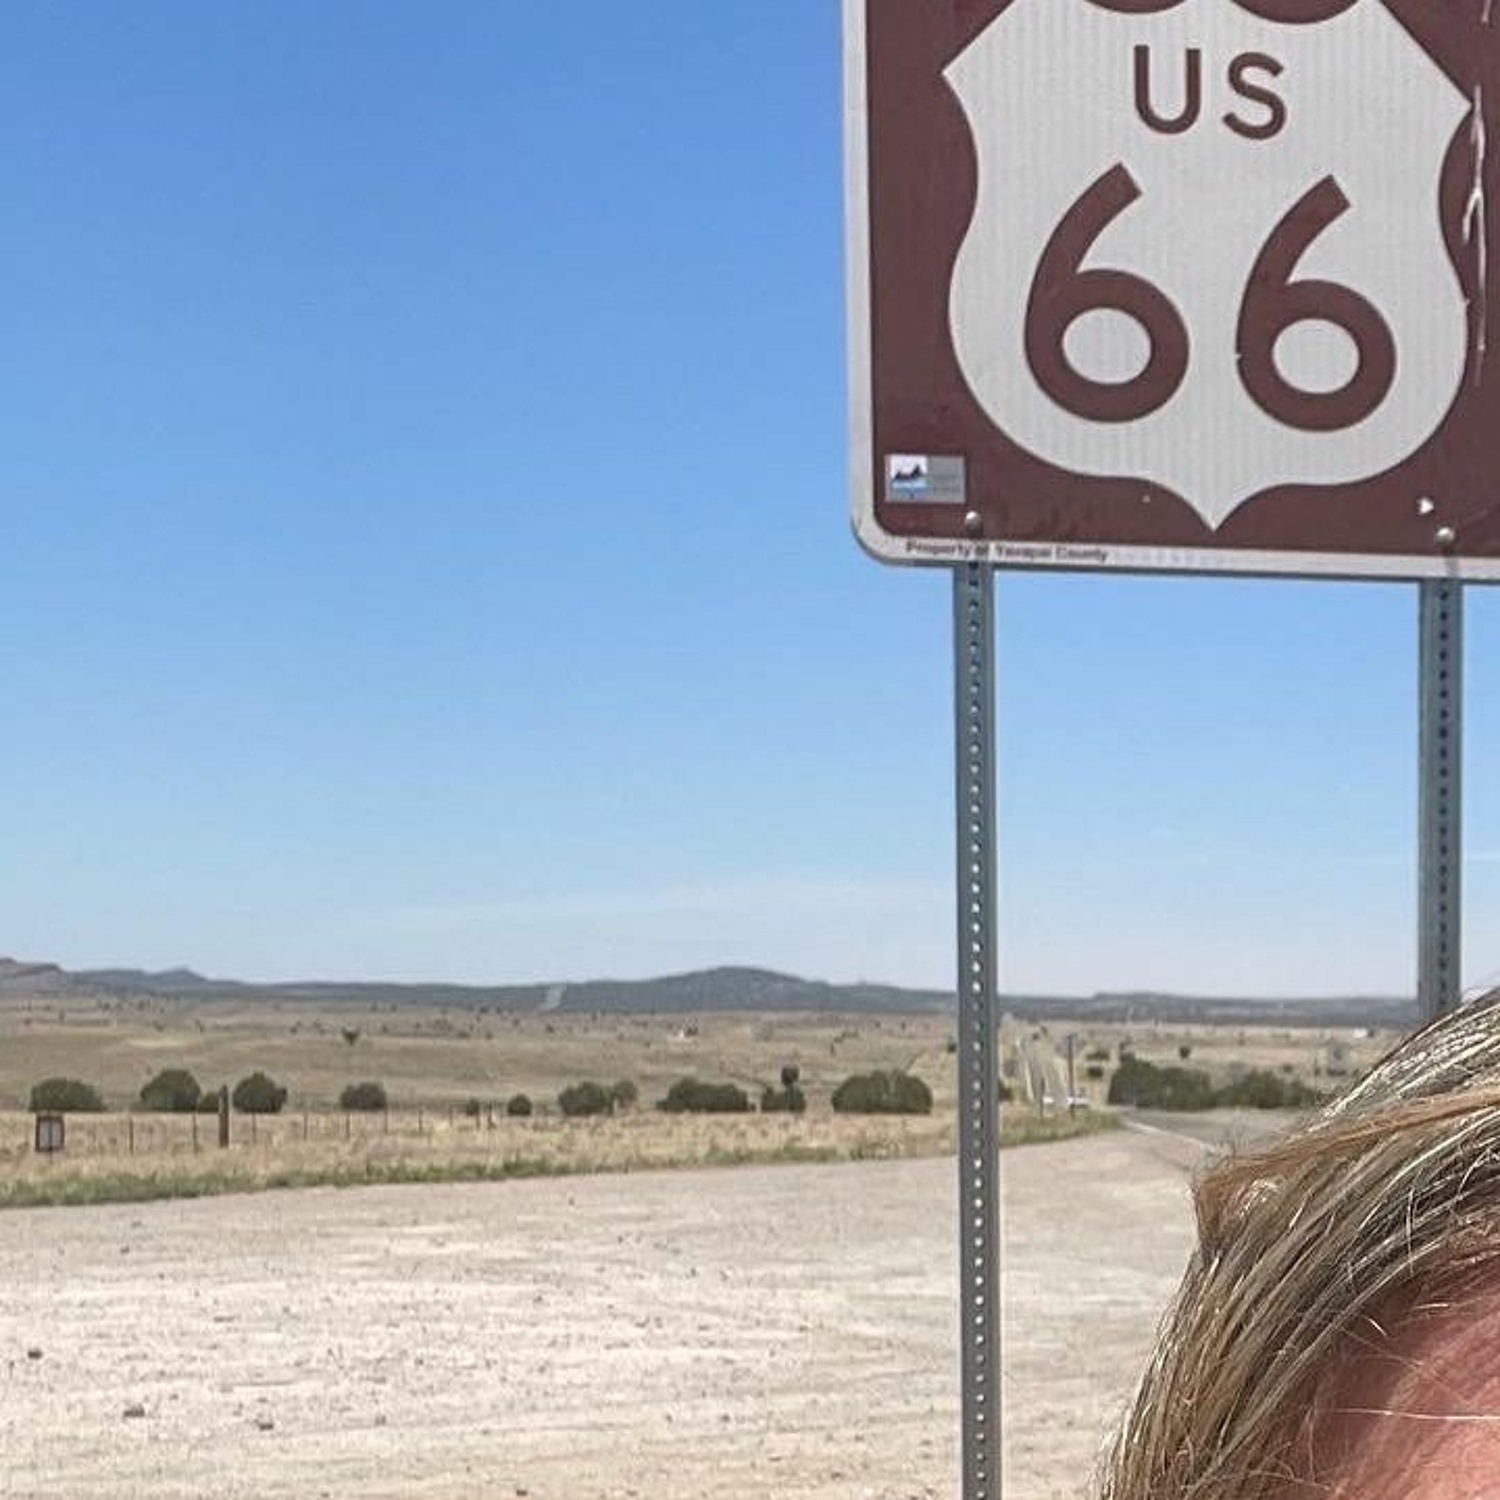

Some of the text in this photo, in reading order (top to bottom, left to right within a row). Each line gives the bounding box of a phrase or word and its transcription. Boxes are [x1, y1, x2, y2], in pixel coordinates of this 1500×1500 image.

[1134, 45, 1286, 140] US
[1024, 162, 1398, 433] 66
[905, 541, 971, 559] Property
[1055, 547, 1108, 563] County
